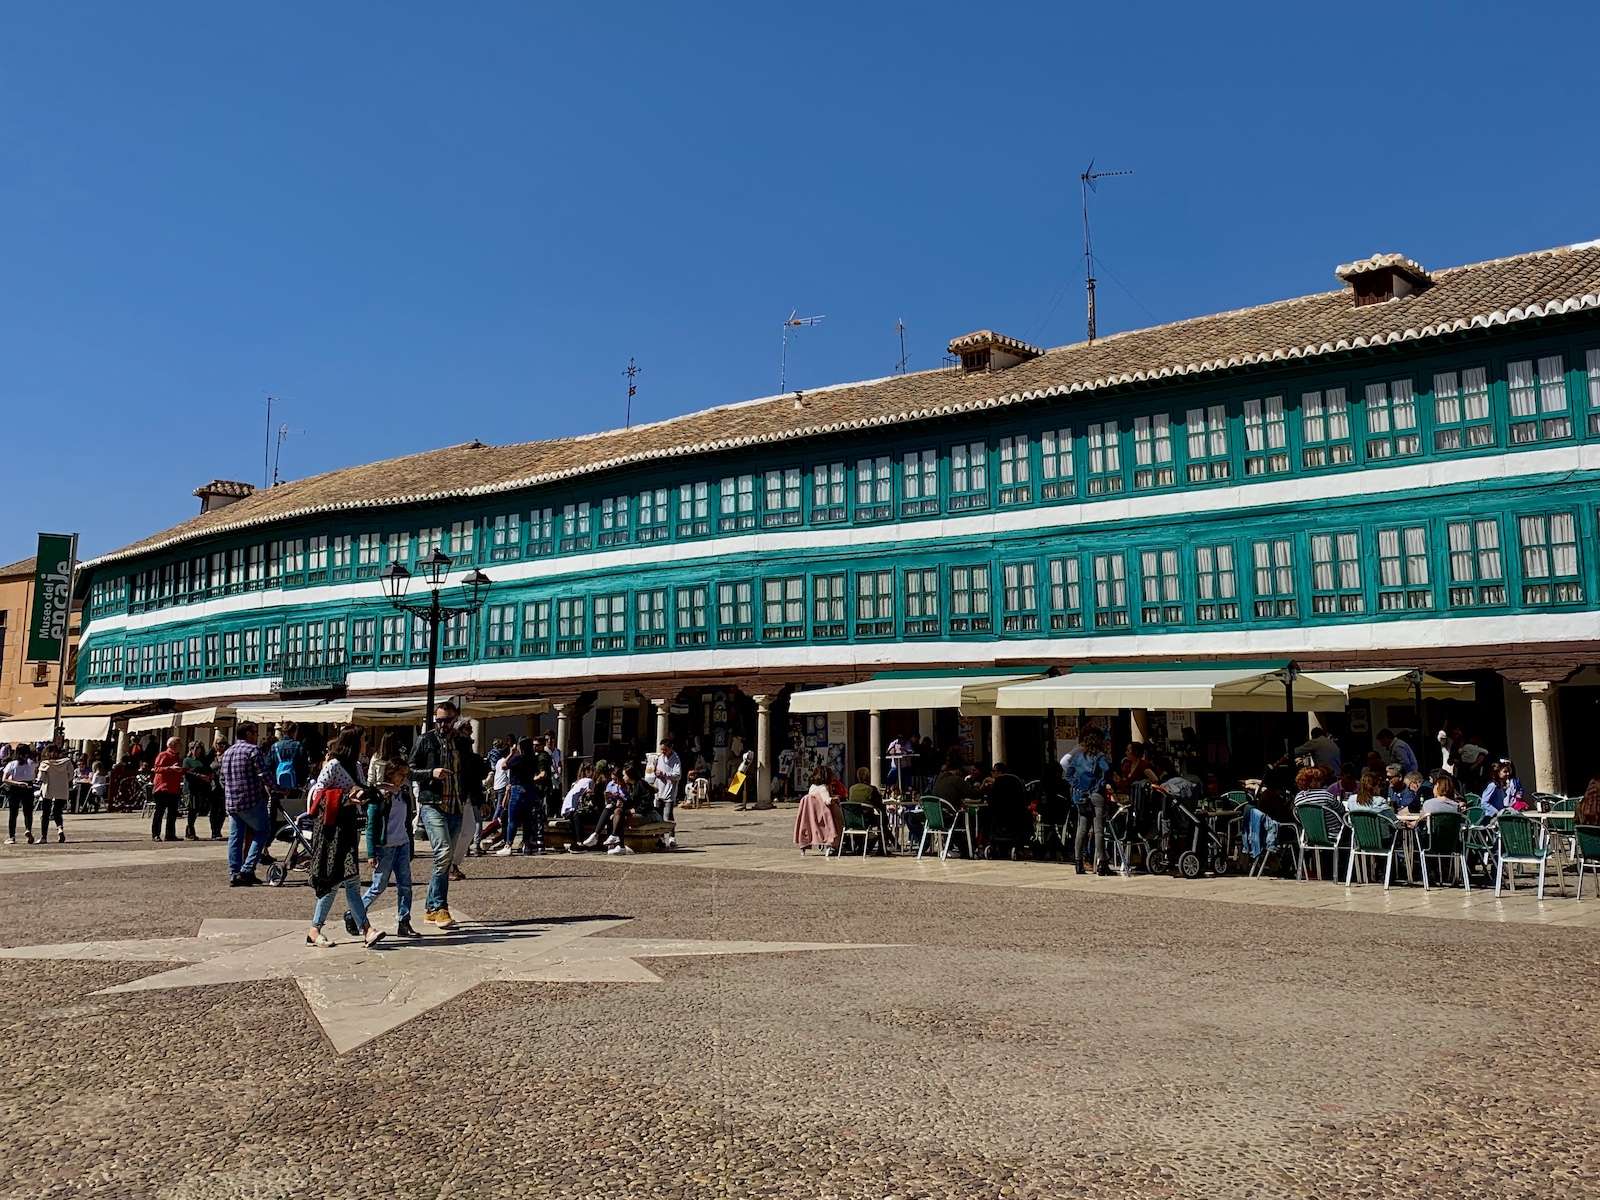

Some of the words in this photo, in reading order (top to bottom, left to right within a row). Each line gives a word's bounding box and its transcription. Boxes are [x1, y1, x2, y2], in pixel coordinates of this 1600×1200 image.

[41, 560, 70, 640] encaje
[43, 583, 54, 600] del
[39, 602, 52, 639] Museo
